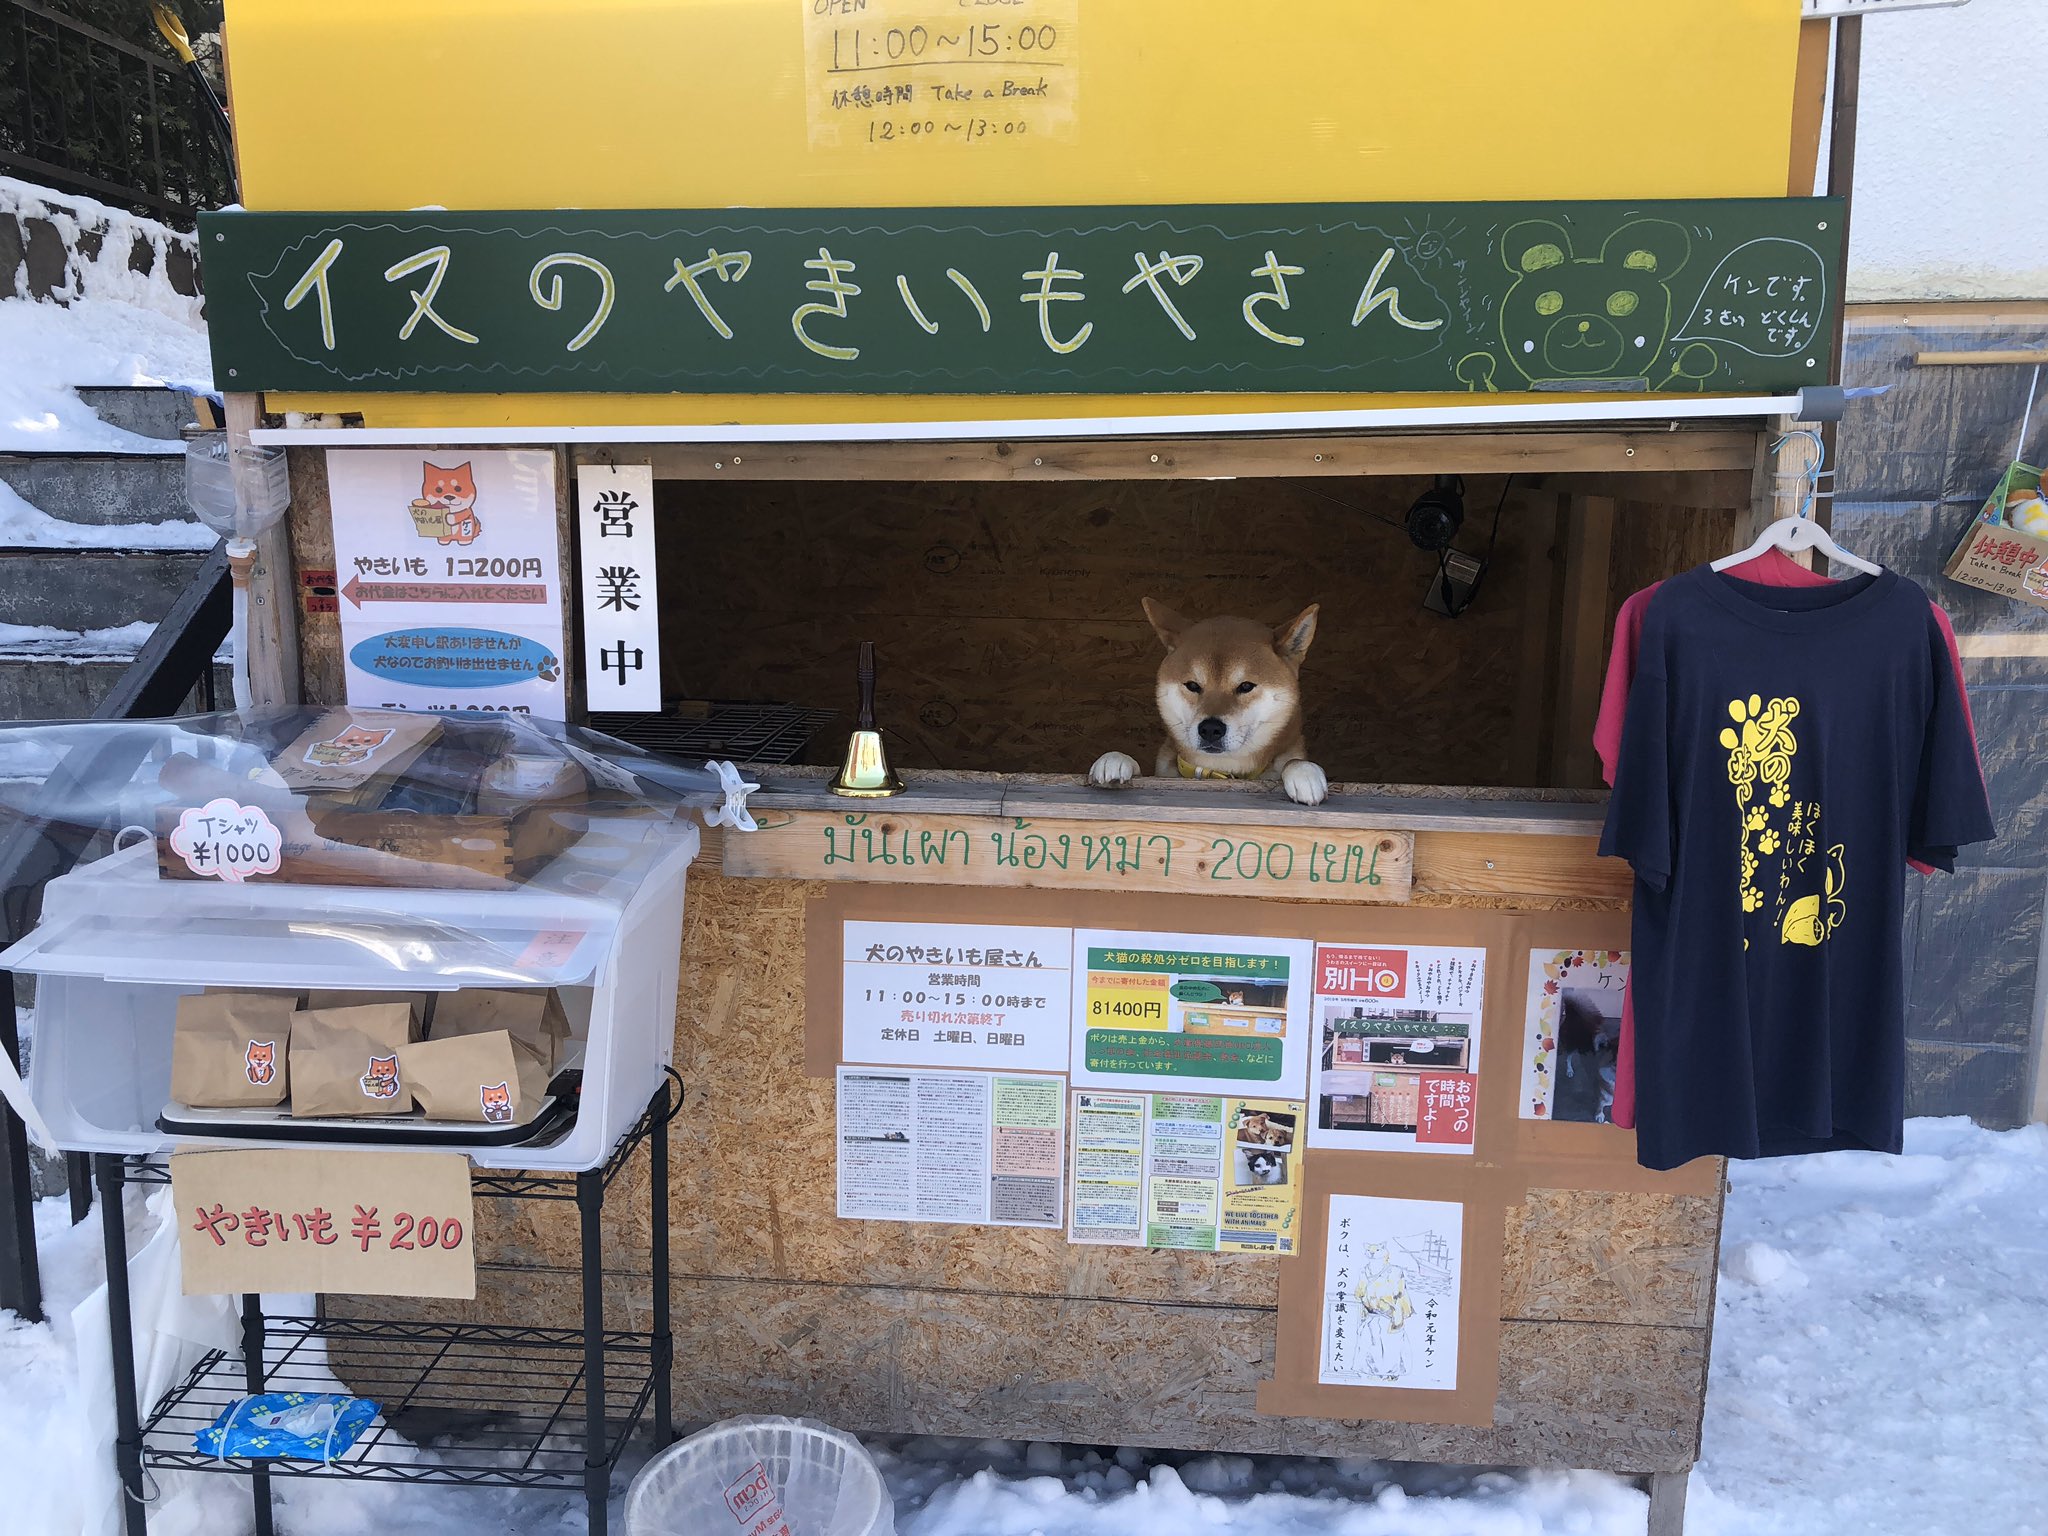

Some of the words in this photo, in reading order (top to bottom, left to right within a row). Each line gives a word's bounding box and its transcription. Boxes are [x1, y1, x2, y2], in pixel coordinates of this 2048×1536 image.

[832, 85, 912, 109] 休憩時間
[931, 83, 973, 101] Take
[983, 88, 994, 98] a
[1002, 77, 1047, 97] Break
[286, 239, 1443, 354] イヌのやきいもやさん
[1760, 309, 1812, 328] どくしん
[1768, 326, 1803, 349] です。
[1974, 534, 2040, 569] 休憩中
[353, 557, 428, 577] やきいも
[446, 557, 542, 579] 1コ200円
[1970, 556, 1989, 569] Take
[1999, 566, 2022, 579] Break
[355, 584, 545, 601] お代金はこちらに入れてください
[593, 490, 645, 686] 営業中
[384, 636, 522, 651] 大変申し訳ありませんが
[373, 656, 534, 671] 犬なのでお釣りは出せません
[198, 817, 259, 837] Tシャツ
[1796, 802, 1821, 873] ほくほく
[193, 841, 270, 866] ¥1000
[824, 814, 970, 865] มันเผา
[1211, 839, 1293, 880] 200
[1309, 842, 1381, 885] เยน
[1773, 801, 1804, 927] 美味しいわん！
[866, 943, 1042, 968] 犬のやきいも屋さん
[1104, 952, 1279, 969] 犬猫の殺処分ゼロを目指します！
[928, 973, 981, 987] 営業時間
[1091, 976, 1166, 987] 今までに寄付した金額
[900, 1010, 1006, 1026] 売り切れ次第終了
[1093, 1001, 1161, 1019] 81400円
[881, 1028, 920, 1041] 定休日
[933, 1030, 1025, 1046] 土曜日、日曜日
[1440, 1080, 1455, 1108] 時間
[1453, 1080, 1471, 1132] おやつの
[193, 1203, 339, 1247] やきいも
[351, 1204, 463, 1252] ¥200
[1334, 1218, 1351, 1373] ボクは、犬の常識を変えたい
[1425, 1298, 1438, 1369] 令和元年ケン
